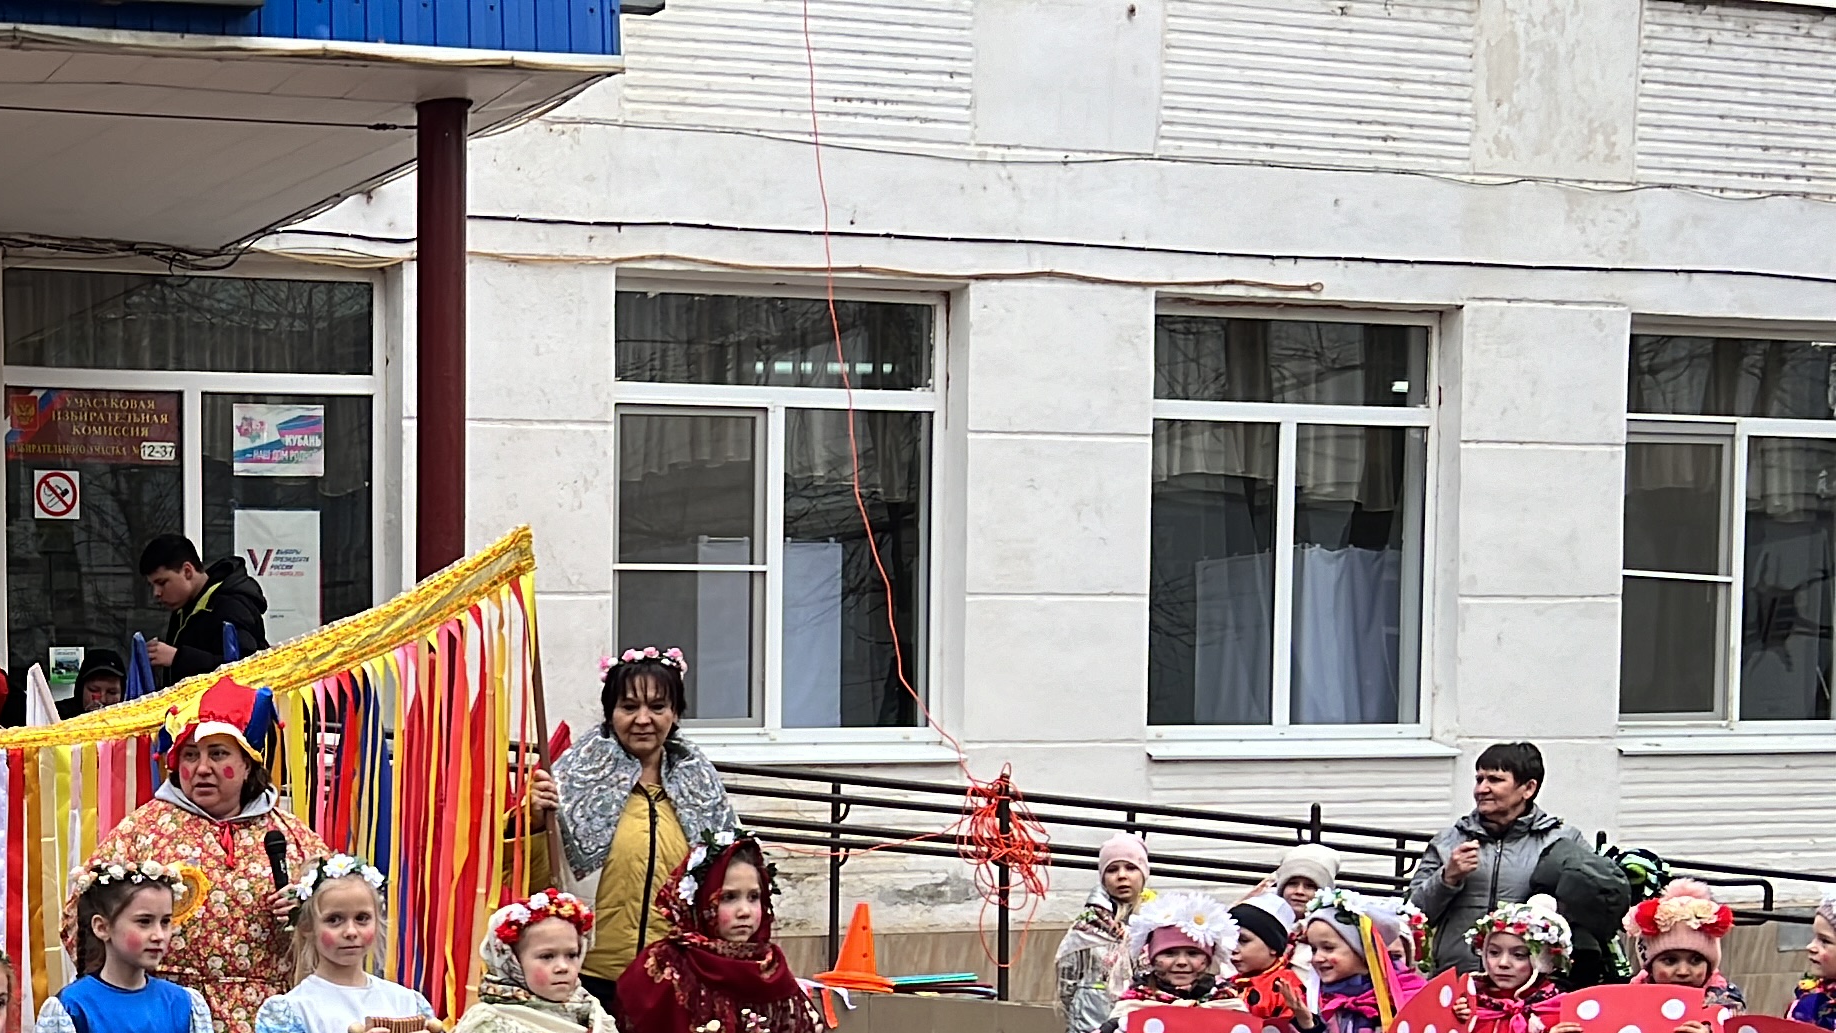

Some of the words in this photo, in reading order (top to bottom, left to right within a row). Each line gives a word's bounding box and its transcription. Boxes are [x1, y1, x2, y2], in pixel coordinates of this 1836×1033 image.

[66, 397, 156, 410] УЧАСТКОВАЯ
[51, 410, 168, 425] ИЗБИРАТЕЛЬНАЯ
[72, 426, 150, 438] КОМИССИЯ
[285, 434, 322, 448] КУБАНЬ
